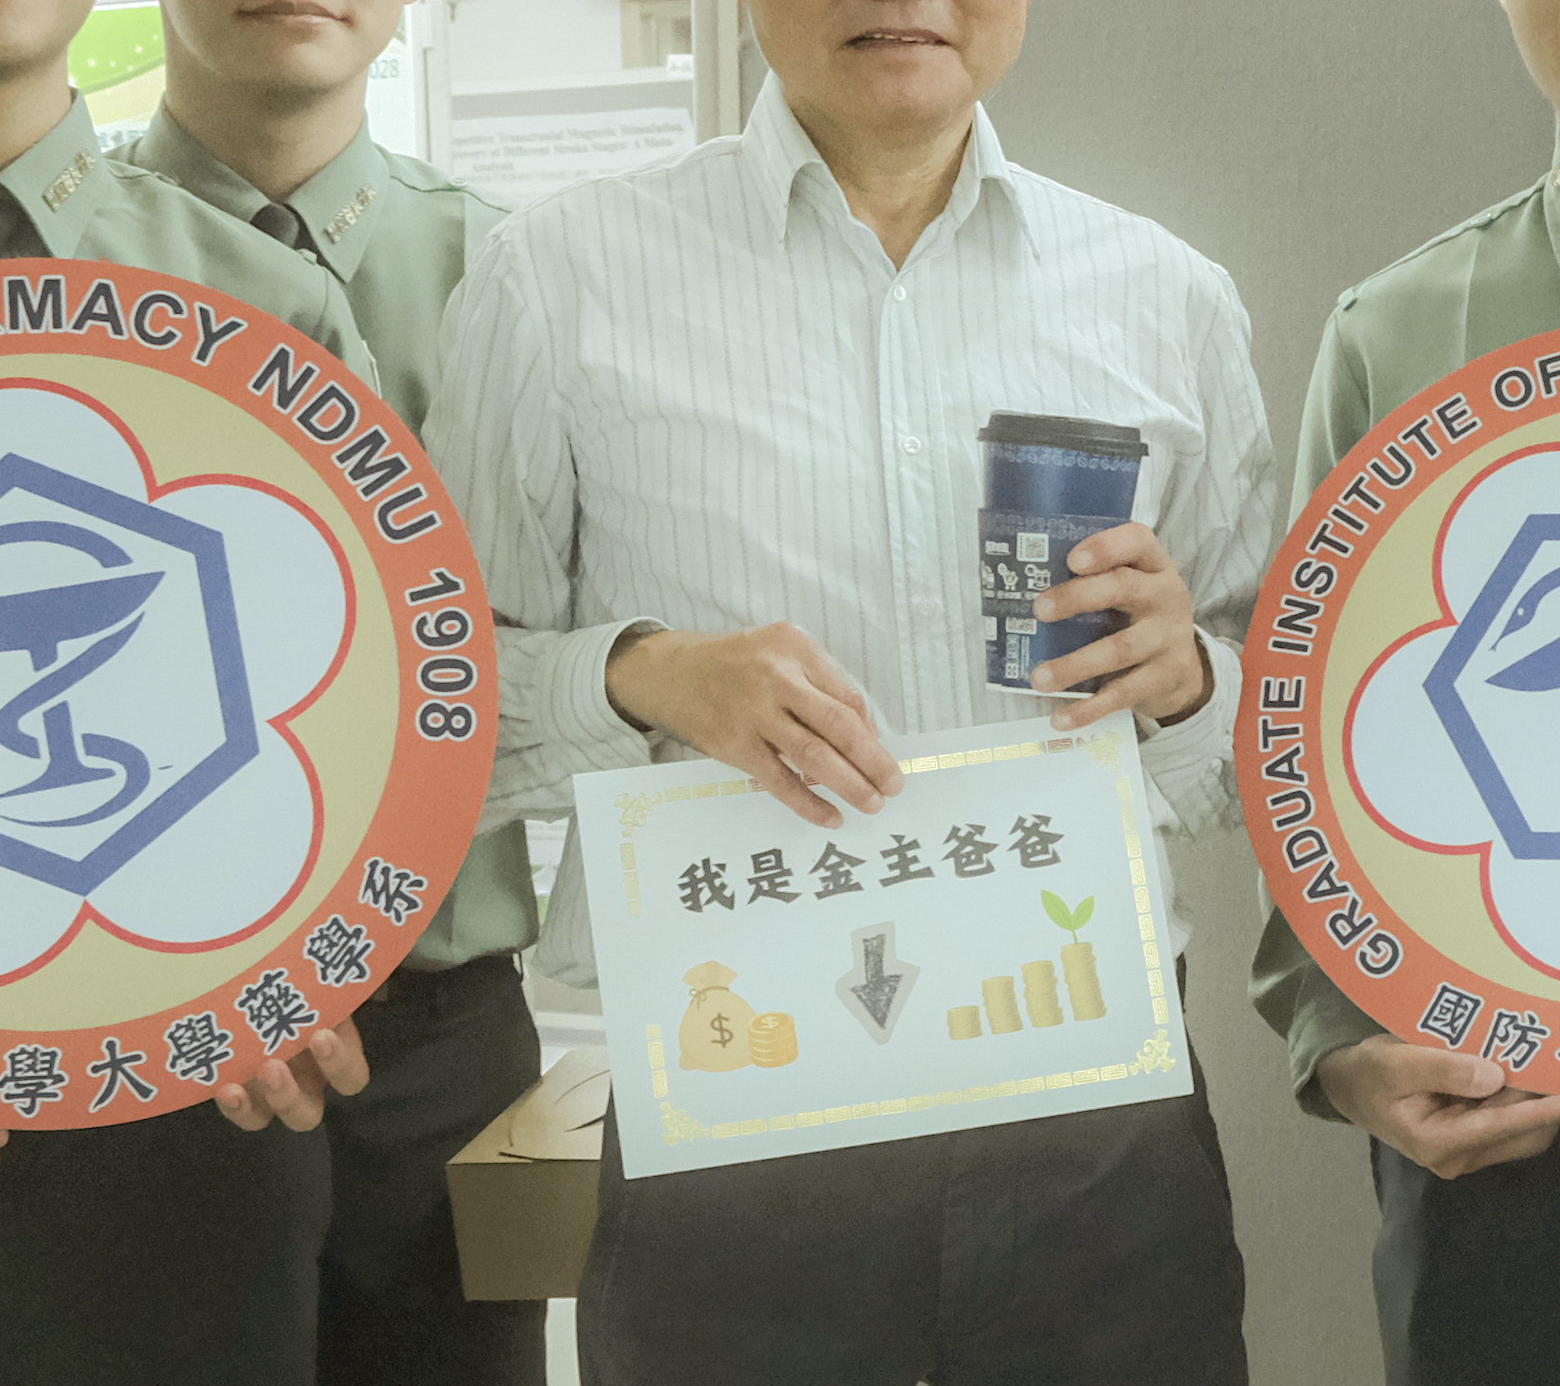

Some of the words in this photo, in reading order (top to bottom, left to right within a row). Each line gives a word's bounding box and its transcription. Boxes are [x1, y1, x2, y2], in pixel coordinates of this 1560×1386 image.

[250, 346, 443, 548] NDMU
[405, 569, 476, 743] 1908
[1269, 394, 1482, 657] INSTITUTE
[677, 813, 1065, 914] 我是金主爸爸
[1259, 675, 1405, 979] GRADUATE
